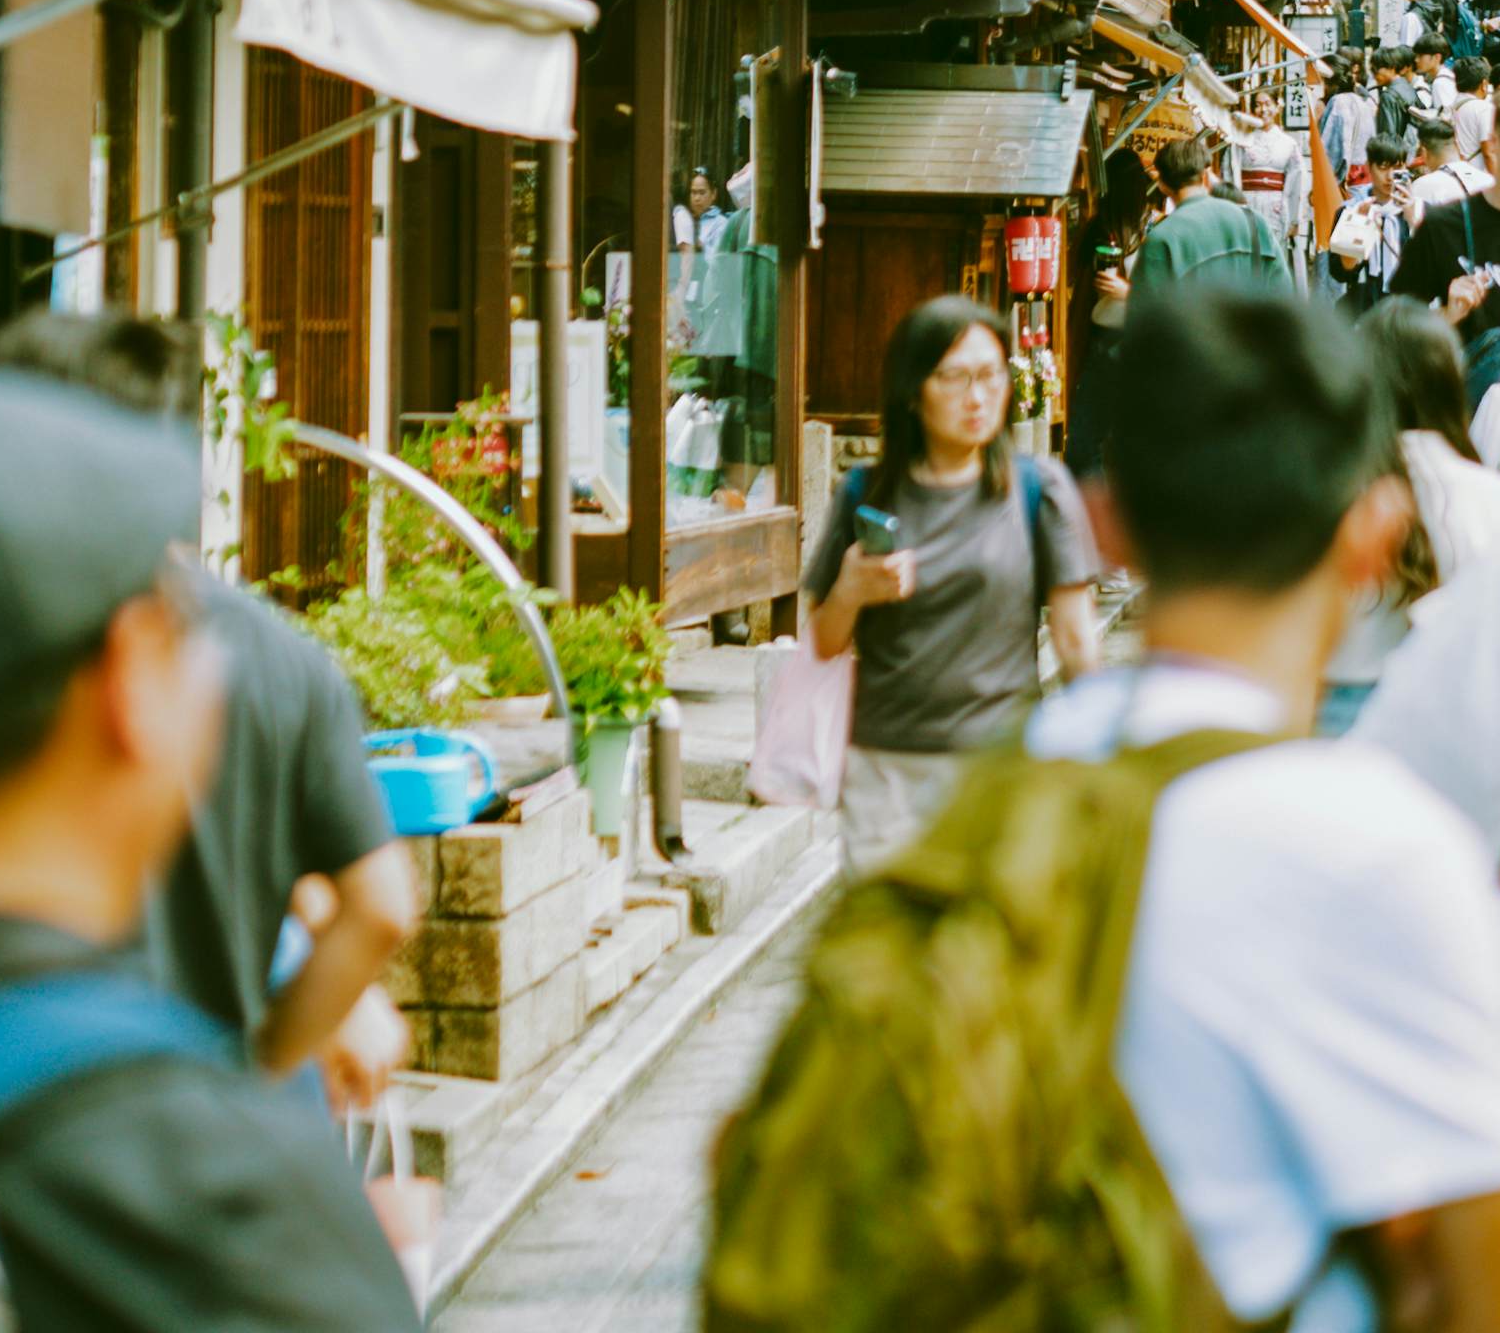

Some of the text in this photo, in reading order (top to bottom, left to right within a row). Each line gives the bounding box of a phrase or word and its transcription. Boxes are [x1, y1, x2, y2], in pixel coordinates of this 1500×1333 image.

[1322, 26, 1334, 52] そば
[1288, 72, 1309, 118] ふたば
